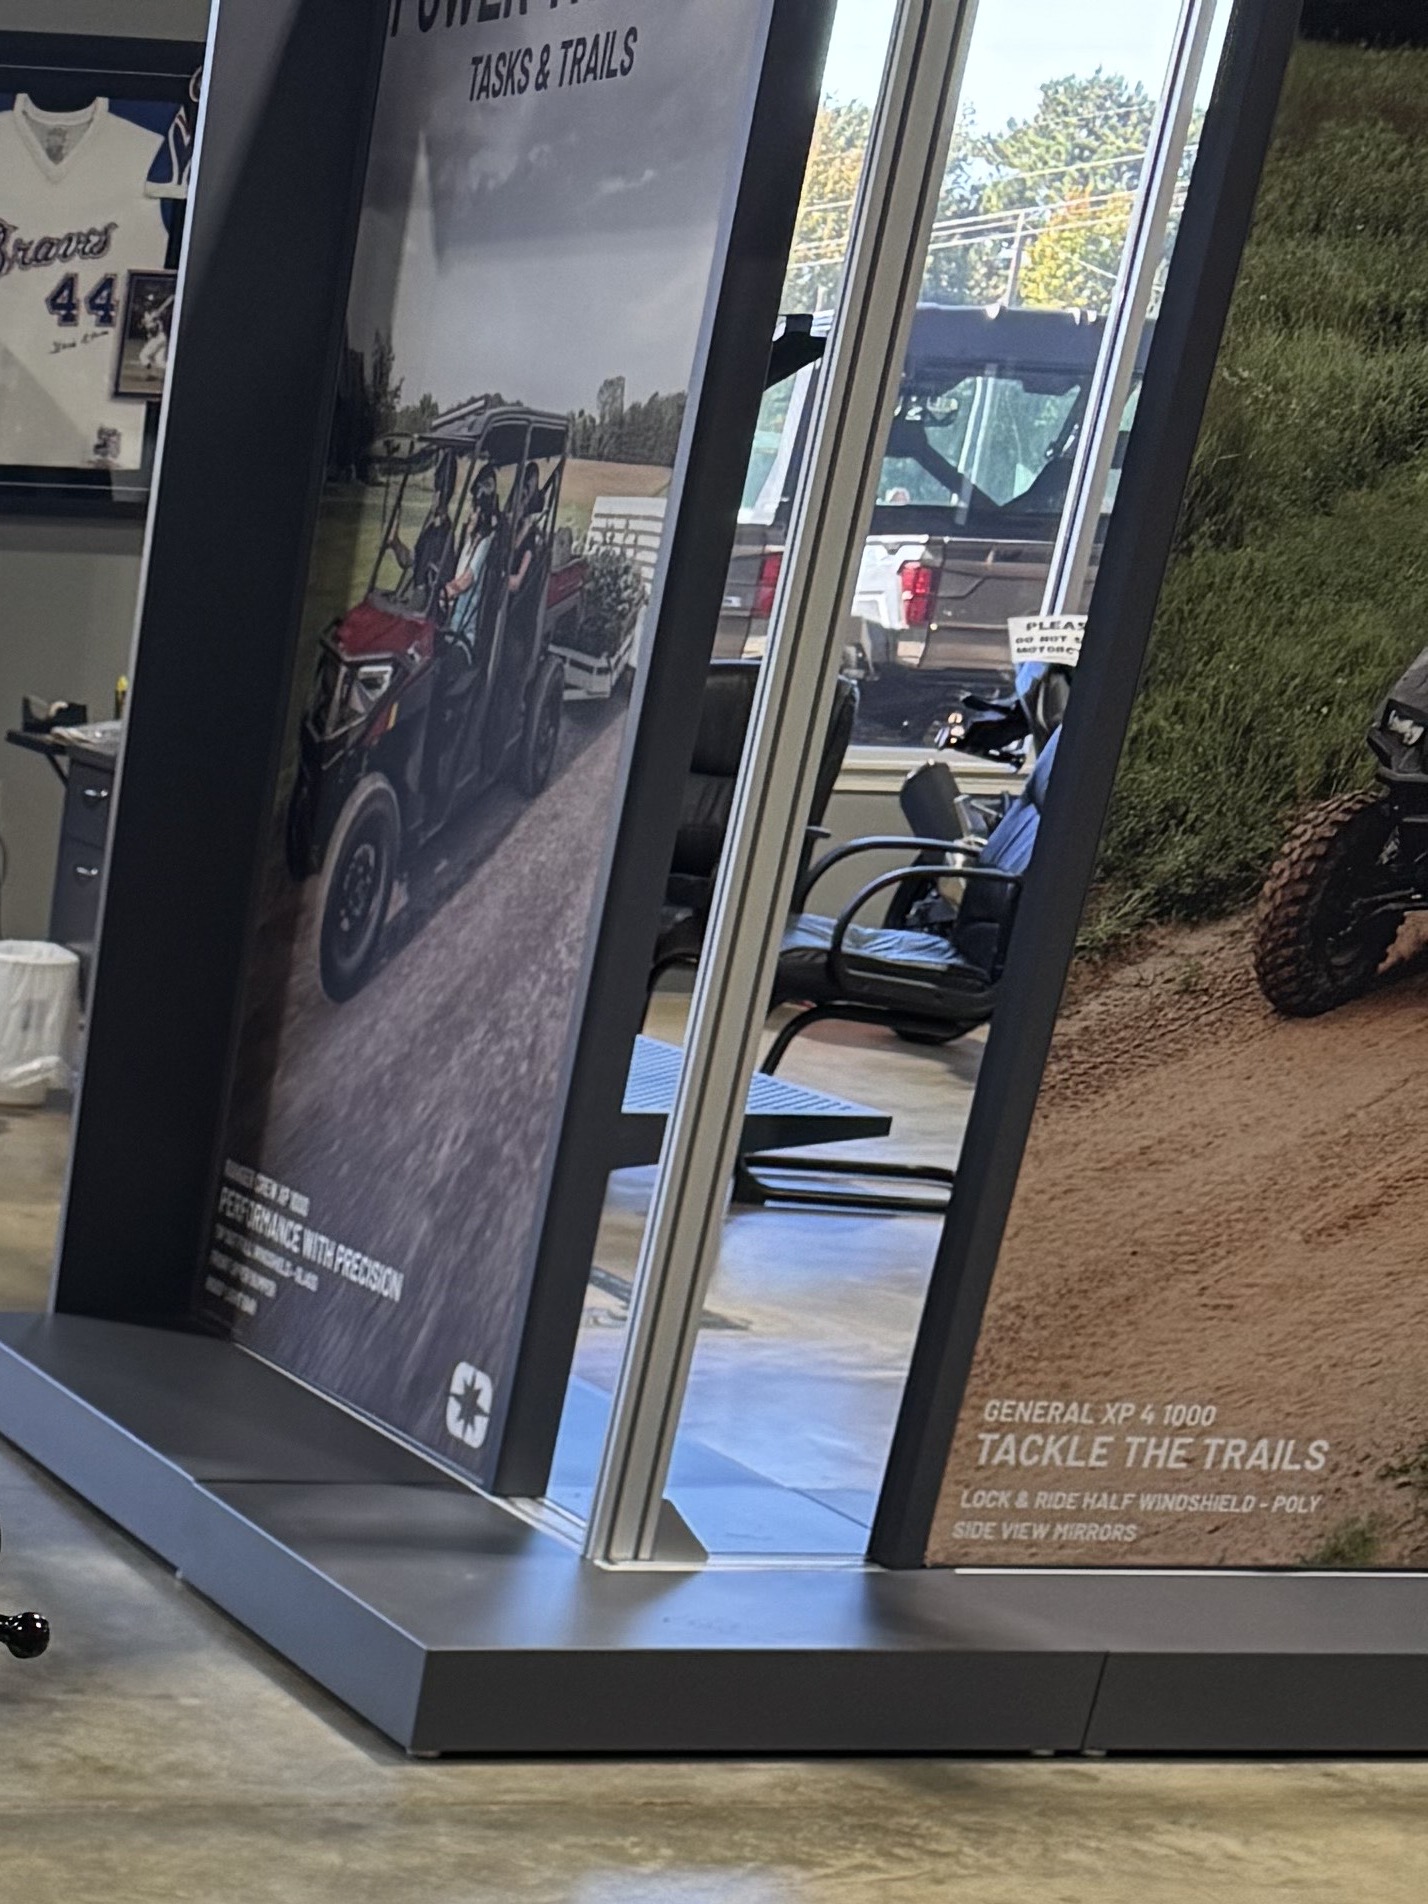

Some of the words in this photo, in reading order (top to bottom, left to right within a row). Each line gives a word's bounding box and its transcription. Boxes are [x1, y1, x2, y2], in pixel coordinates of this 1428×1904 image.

[469, 47, 533, 101] TASKS
[535, 44, 550, 91] &
[558, 26, 638, 87] TRAILS
[44, 272, 118, 327] 44
[1026, 622, 1085, 631] PLEAS
[218, 1187, 302, 1253] PERFORMANCE
[302, 1228, 337, 1270] WITH
[333, 1243, 404, 1303] PRECISION
[983, 1400, 1093, 1425] GENERAL
[1101, 1404, 1135, 1426] XP
[1140, 1405, 1155, 1426] 4
[1163, 1404, 1217, 1427] 1000
[976, 1432, 1113, 1468] TACKLE
[1125, 1436, 1194, 1470] THE
[1203, 1437, 1330, 1472] TRAILS
[960, 1490, 1011, 1509] LOCK
[1014, 1491, 1029, 1509] &
[1035, 1491, 1079, 1510] RIDE
[1081, 1492, 1135, 1511] HALF
[1139, 1494, 1255, 1513] WINDSHIELD
[1272, 1495, 1323, 1513] POLY
[952, 1521, 995, 1540] SIDE
[1001, 1522, 1051, 1540] VIEW
[1052, 1523, 1138, 1542] MIRRORS
